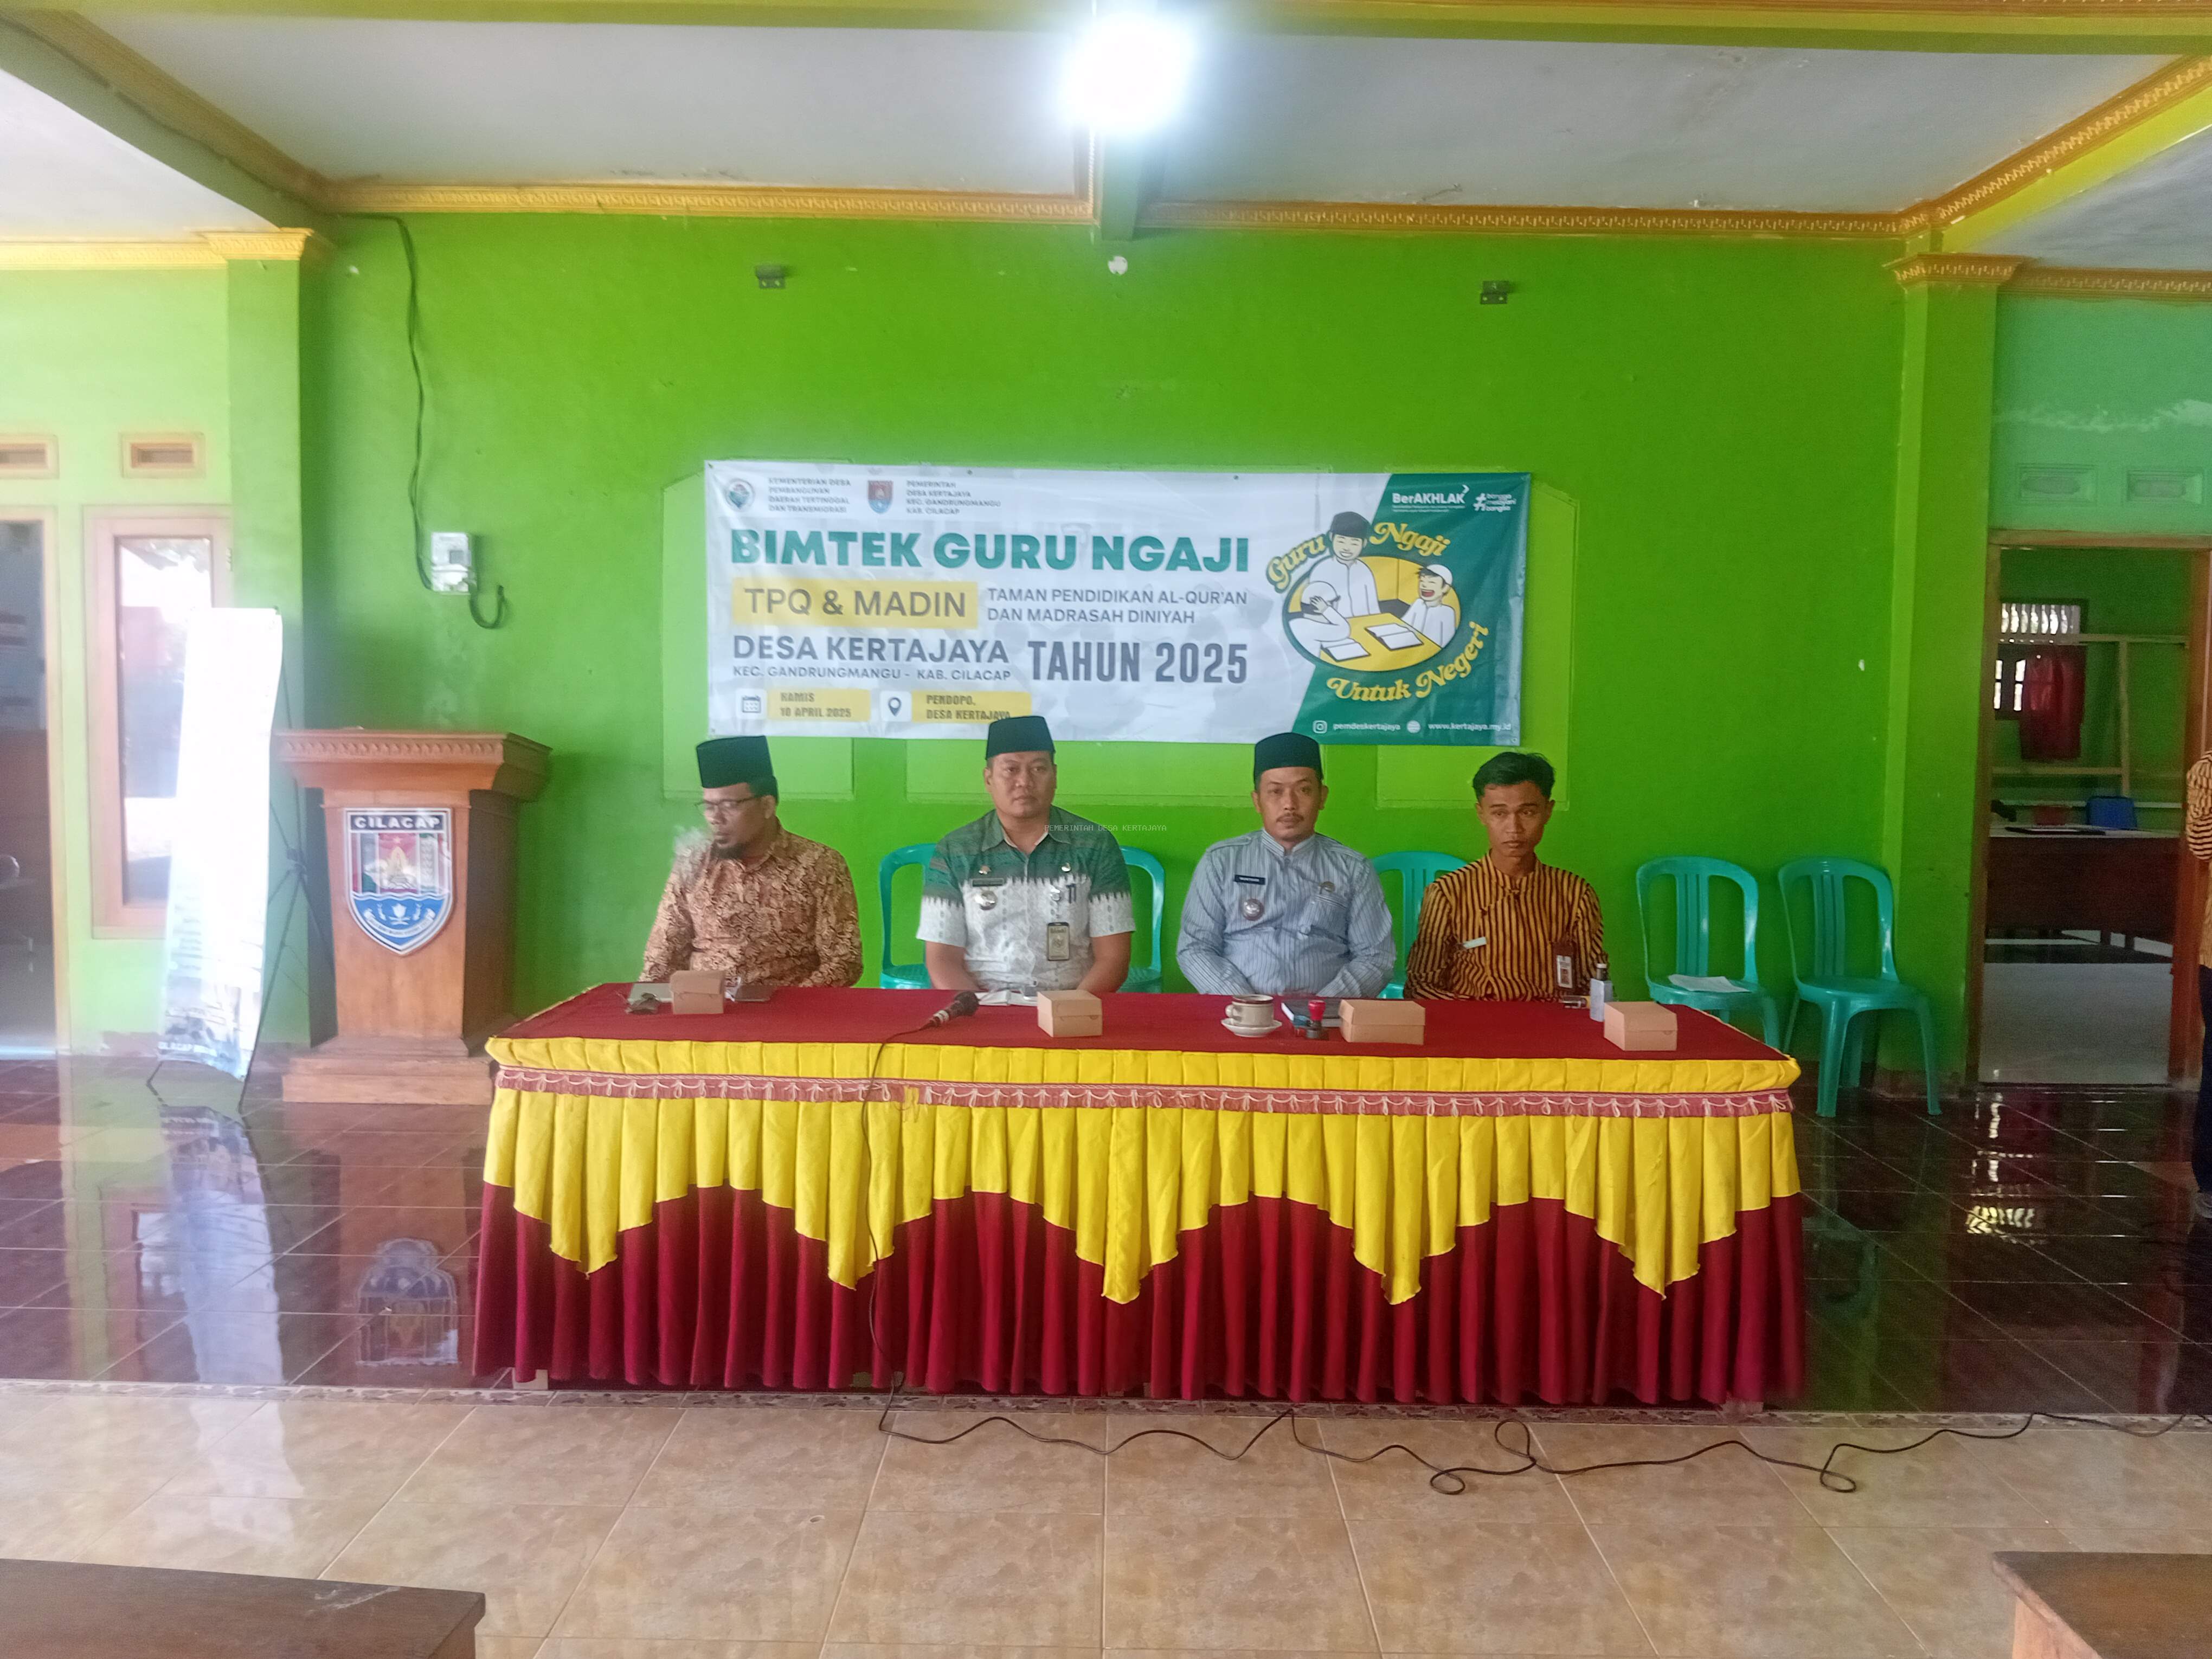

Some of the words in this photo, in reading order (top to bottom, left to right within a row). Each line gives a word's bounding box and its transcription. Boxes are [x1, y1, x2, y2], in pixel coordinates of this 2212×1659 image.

[828, 478, 851, 486] DESA
[1392, 493, 1465, 504] BerAKHLAK
[731, 529, 923, 568] BIMTEK
[934, 532, 1077, 570] GURU
[1092, 536, 1249, 573] NGAJI
[1266, 534, 1327, 593] Guru
[1369, 522, 1451, 557] Ngaji
[744, 588, 812, 615] TPQ
[822, 590, 844, 615] &
[854, 590, 966, 618] MADIN
[988, 588, 1047, 602] TAMAN
[1052, 589, 1153, 603] PENDIDIKAN
[988, 608, 1023, 621] DAN
[1028, 609, 1124, 623] MADRASAH
[1129, 610, 1195, 624] DINIYAH
[733, 635, 818, 660] DESA
[827, 637, 1009, 664] KERTAJAYA
[1028, 641, 1140, 682] TAHUN
[1155, 642, 1247, 684] 2025
[733, 666, 764, 677] KEC.
[768, 667, 901, 679] GANDRUNGMANGU
[917, 670, 947, 680] KAB.
[951, 670, 1011, 681] CILACAP
[781, 692, 815, 702] KAMIS
[1327, 678, 1412, 701] Untuk
[795, 708, 824, 717] APRIL
[826, 708, 852, 718] 2025
[927, 710, 953, 719] DESA
[956, 710, 1011, 721] KERTAJAYA
[355, 816, 440, 829] CILACAP
